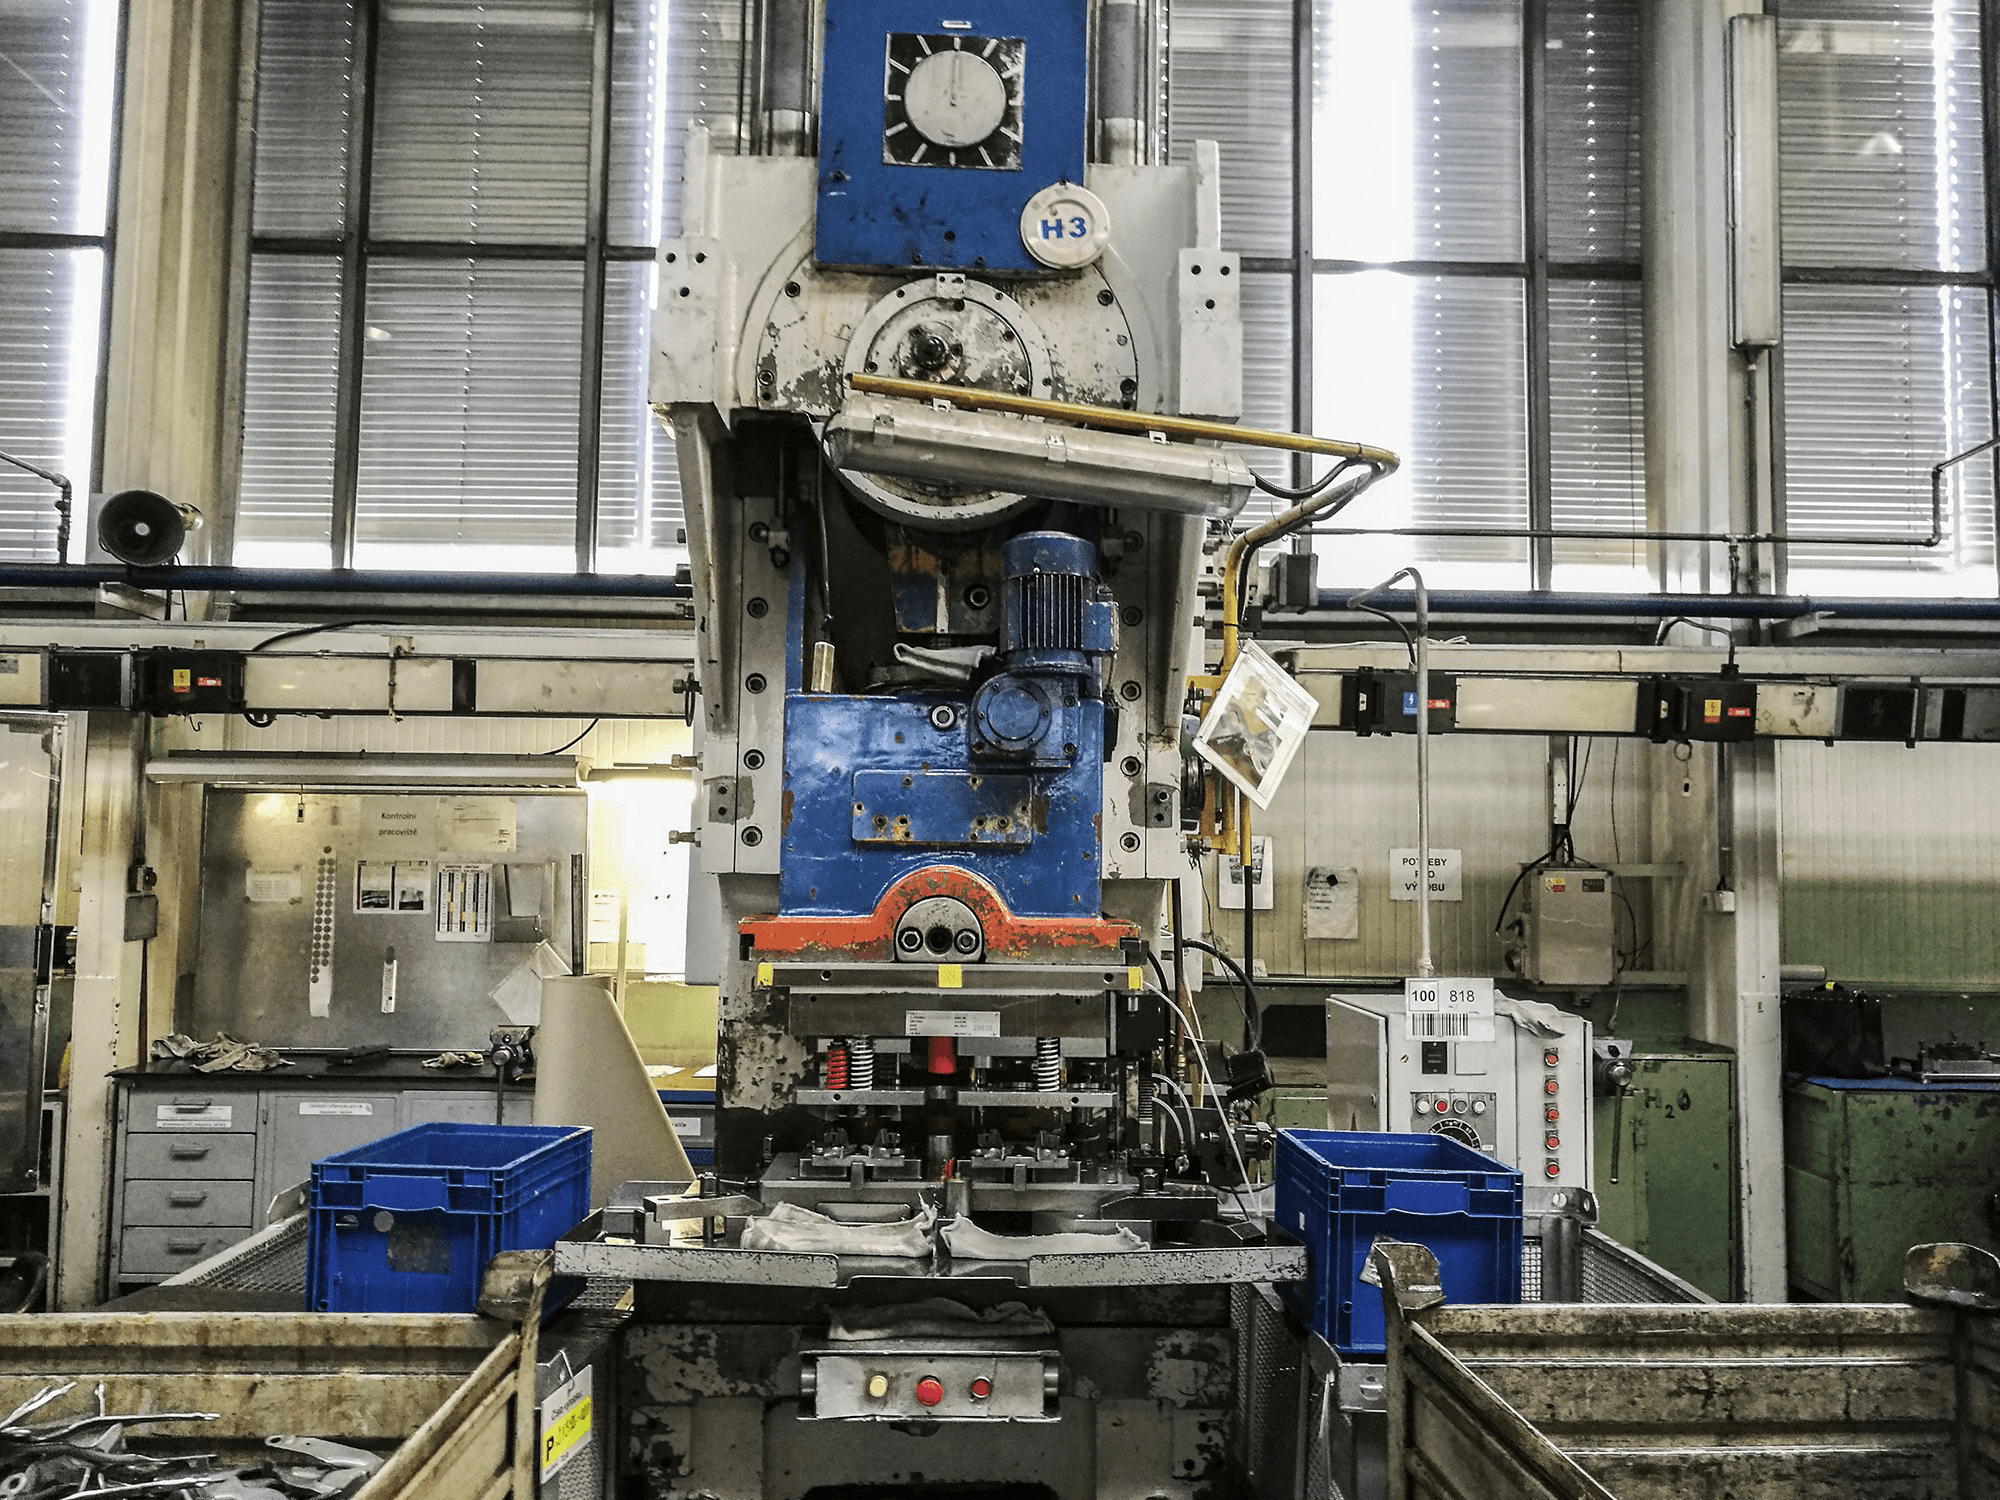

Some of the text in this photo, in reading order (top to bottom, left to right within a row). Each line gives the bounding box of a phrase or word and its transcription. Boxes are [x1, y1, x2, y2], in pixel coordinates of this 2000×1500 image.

[1402, 857, 1447, 866] POEBY
[1415, 870, 1435, 878] PO
[1405, 881, 1445, 892] VÝBU
[1411, 989, 1475, 1002] 100 818
